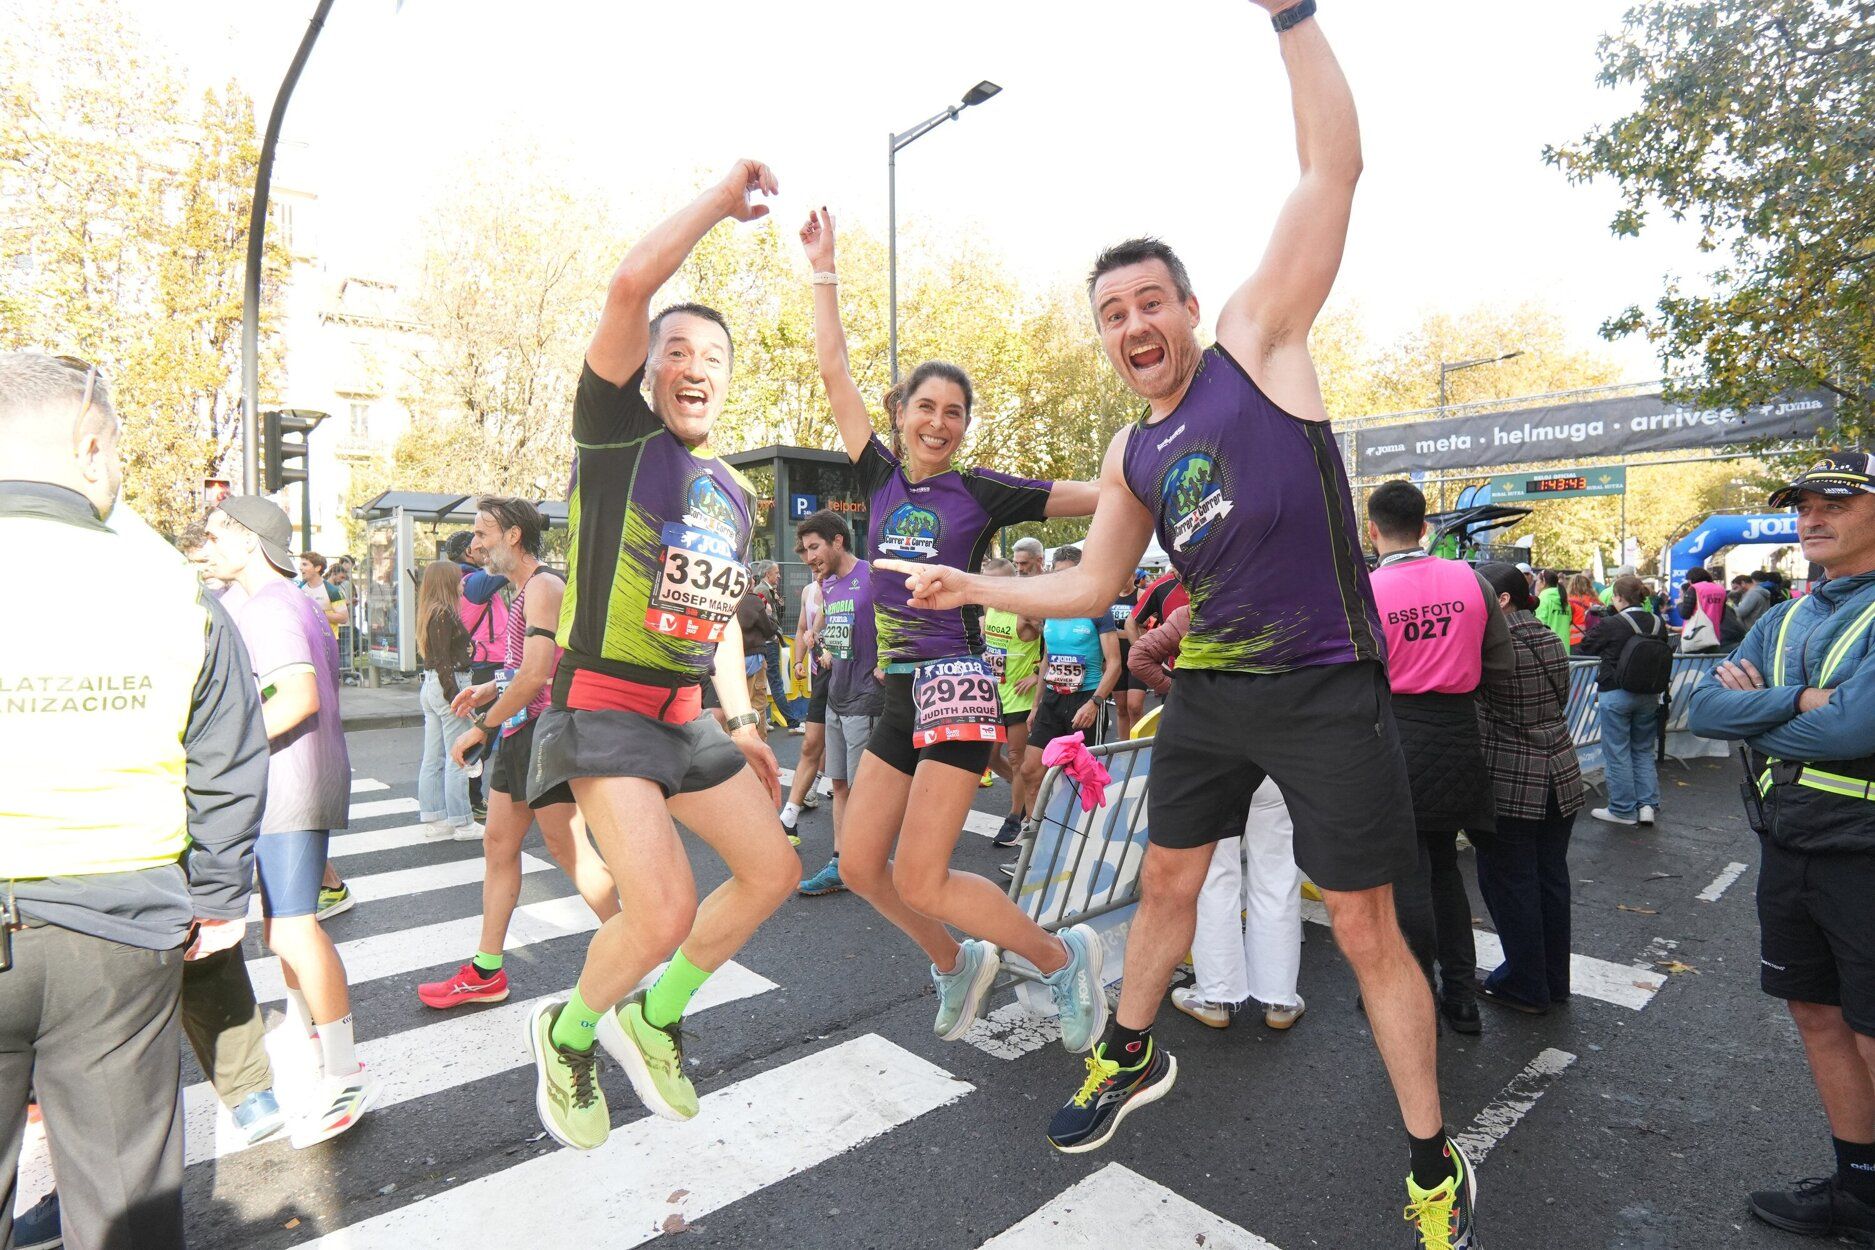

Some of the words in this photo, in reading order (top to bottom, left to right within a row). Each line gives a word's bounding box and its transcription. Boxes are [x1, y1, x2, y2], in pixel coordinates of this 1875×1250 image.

[1416, 433, 1471, 454] meta
[1494, 420, 1604, 446] helmuga
[885, 535, 903, 545] Correr
[911, 538, 933, 548] Correr
[665, 553, 745, 599] 3345
[662, 588, 707, 607] JOSEP
[1388, 607, 1419, 625] BSS
[1421, 600, 1465, 619] FOTO
[824, 625, 849, 639] 2230
[1404, 616, 1452, 642] 027
[1050, 664, 1082, 677] 3555
[0, 695, 147, 713] NIZACION
[921, 678, 994, 711] 2929
[922, 706, 959, 722] JUDITH
[961, 704, 995, 717] ARQUÉ
[1077, 968, 1090, 1005] HOKA
